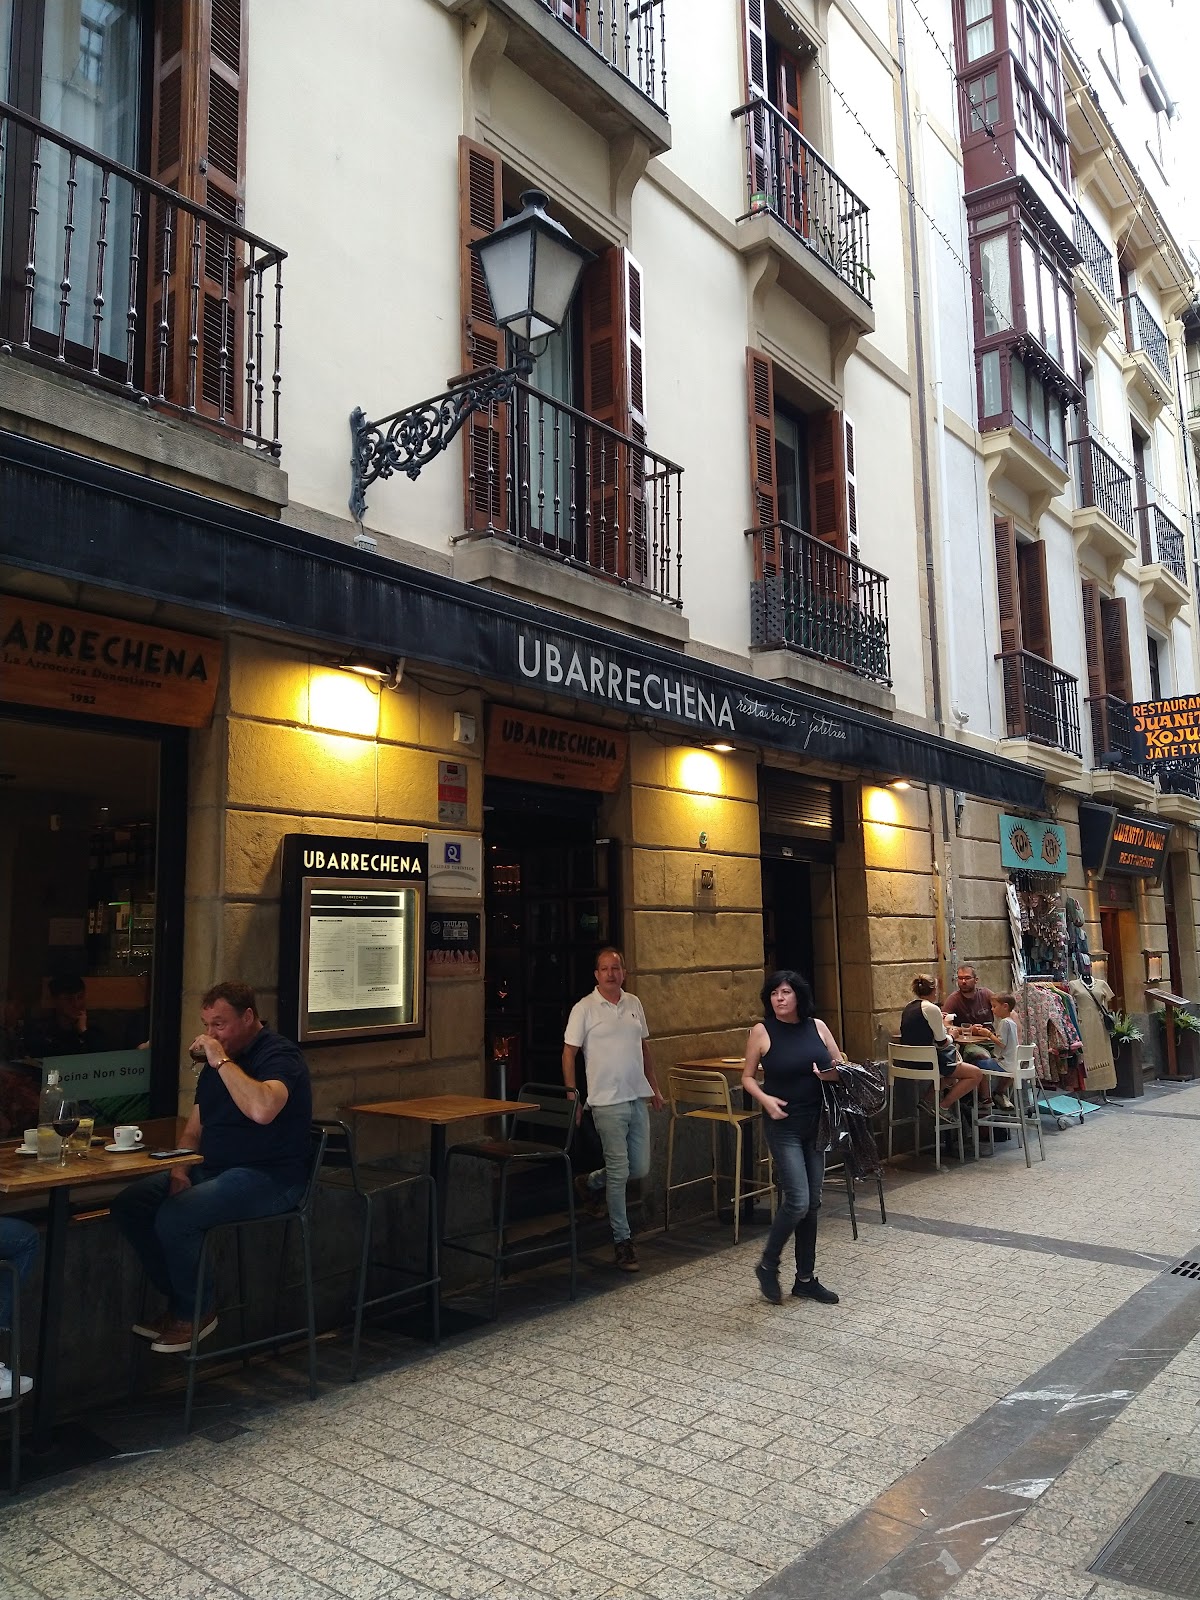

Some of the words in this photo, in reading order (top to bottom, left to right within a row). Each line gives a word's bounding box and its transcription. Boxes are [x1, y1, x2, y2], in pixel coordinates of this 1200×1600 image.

[2, 617, 208, 682] ARRECHENA
[517, 634, 735, 731] UBARRECHENA
[736, 693, 801, 727] restaurante
[70, 692, 96, 705] 1982
[502, 719, 617, 760] UBARRECHENA
[1144, 727, 1200, 747] KOJU
[1145, 743, 1200, 760] JATETX
[1113, 823, 1144, 846] JUANITO
[303, 850, 422, 874] UBARRECHENA
[447, 845, 459, 862] Q
[46, 1072, 88, 1082] ocina
[93, 1069, 115, 1079] Non
[120, 1066, 145, 1076] Stop
